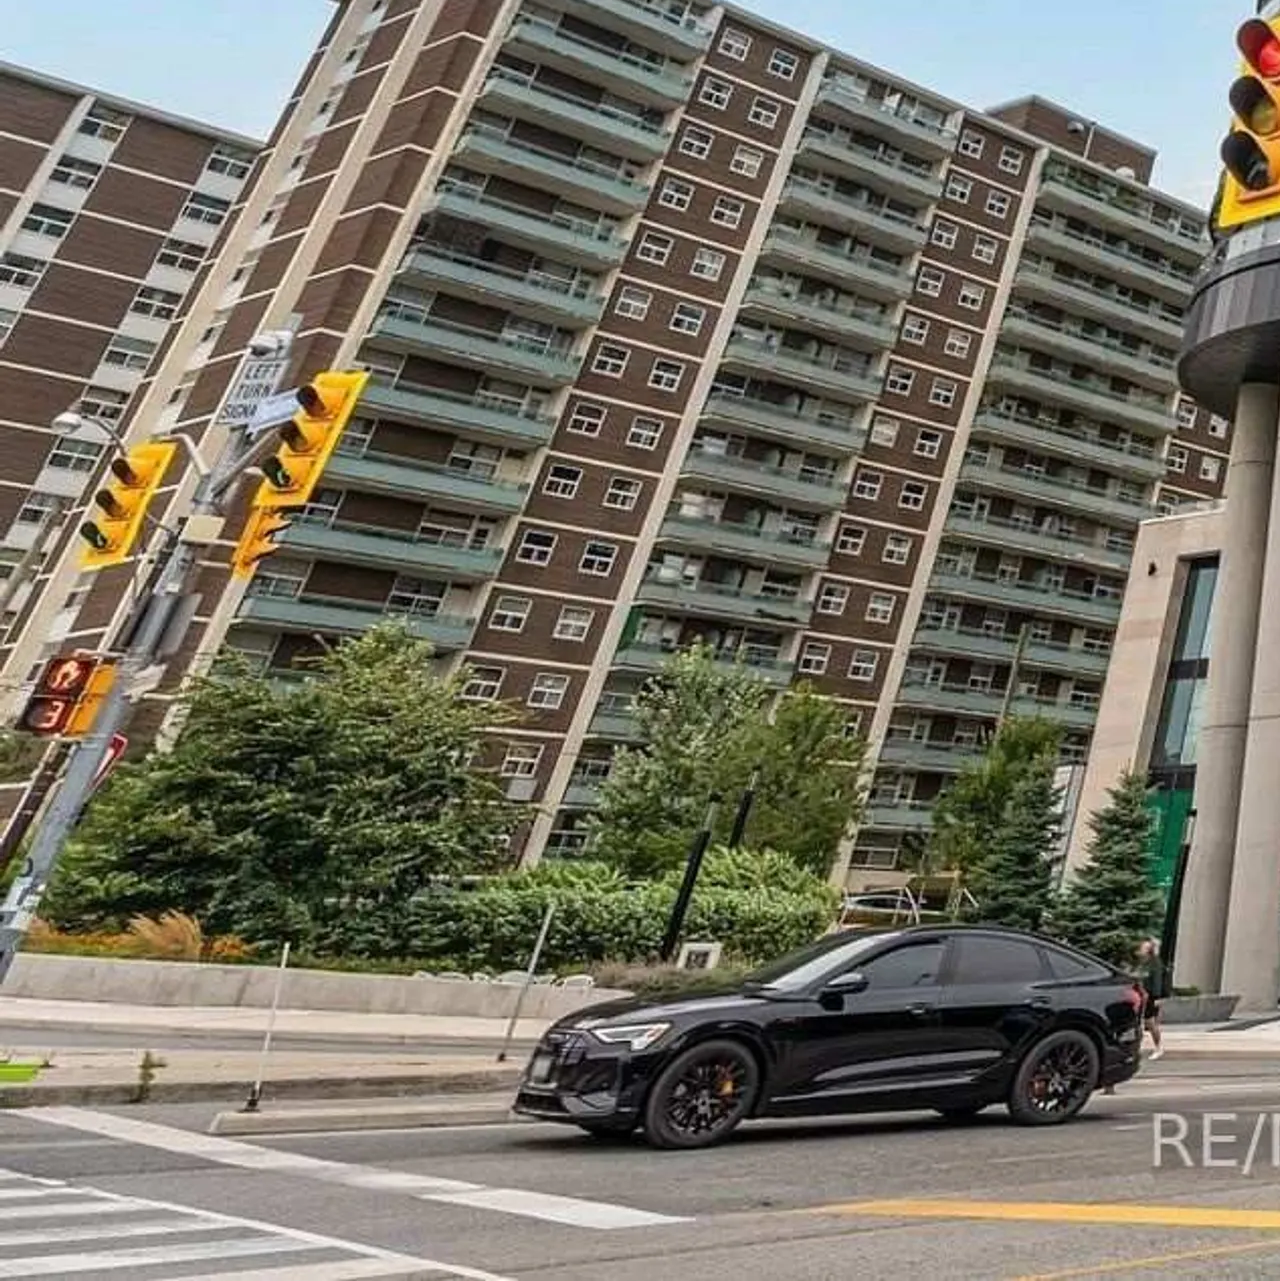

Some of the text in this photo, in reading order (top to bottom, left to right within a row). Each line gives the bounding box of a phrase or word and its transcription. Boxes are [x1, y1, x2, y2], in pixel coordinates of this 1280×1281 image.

[244, 362, 282, 380] LEFT
[235, 383, 271, 399] TURN
[220, 403, 259, 419] SIGNA
